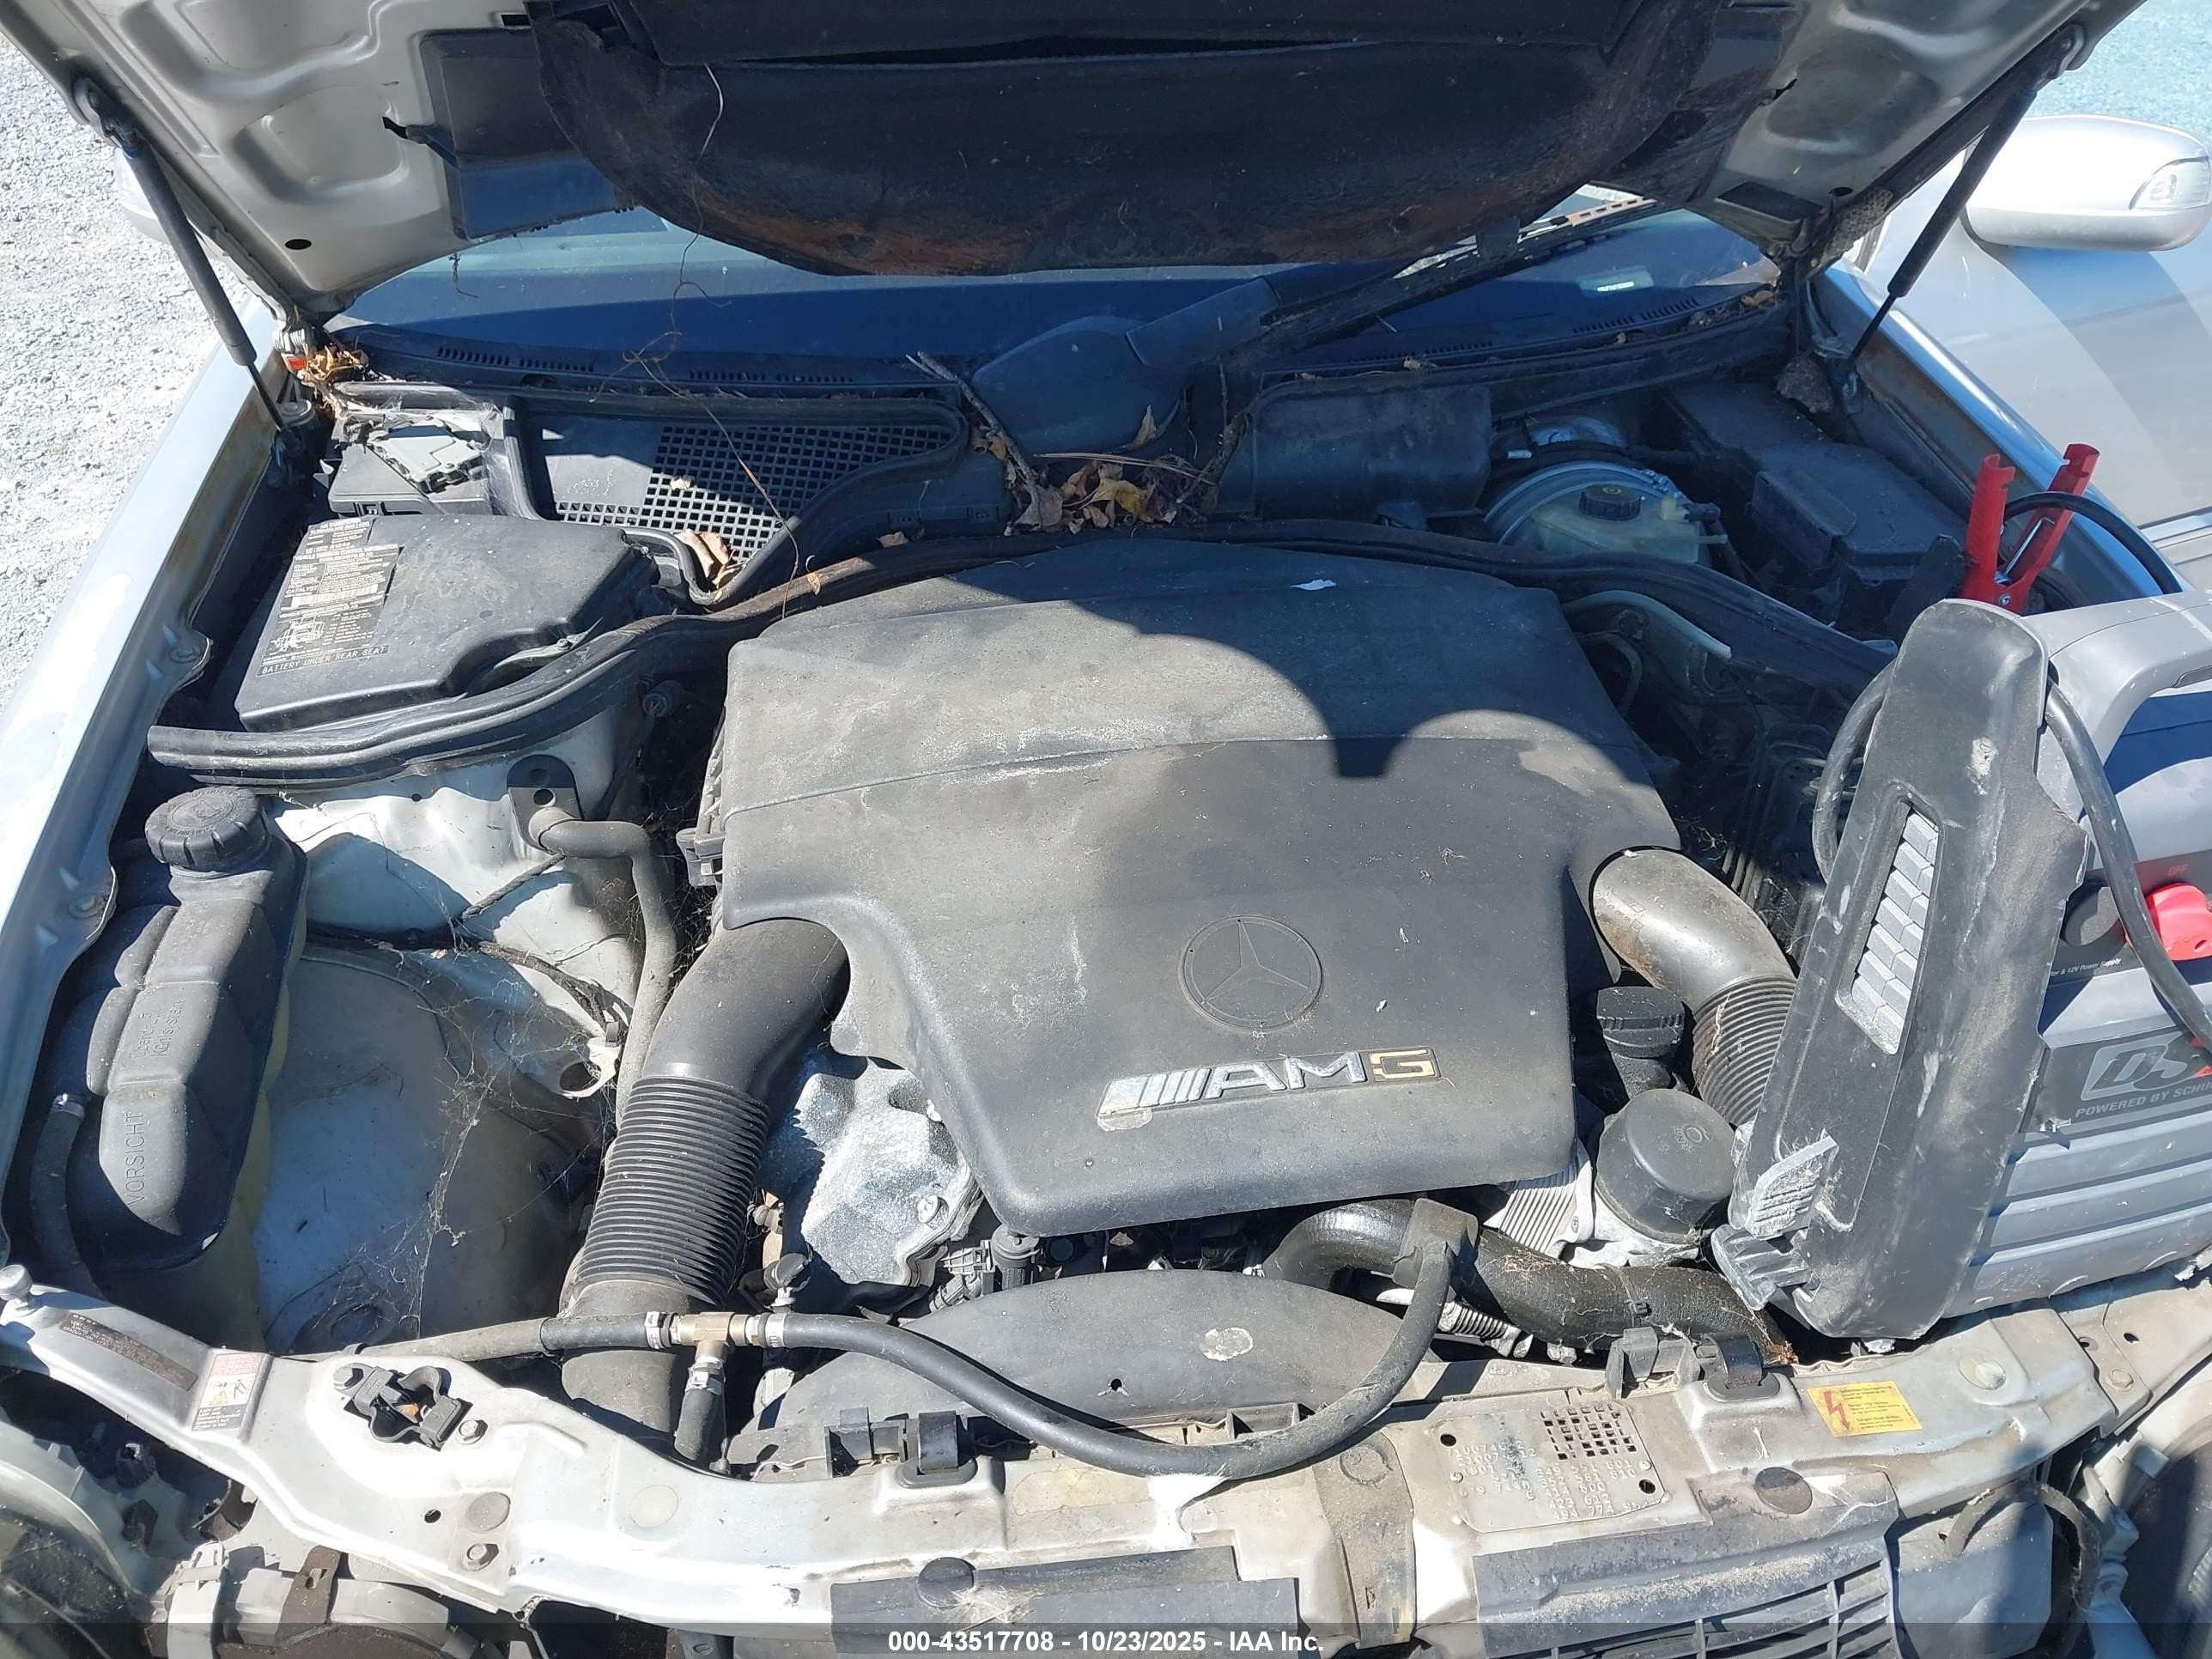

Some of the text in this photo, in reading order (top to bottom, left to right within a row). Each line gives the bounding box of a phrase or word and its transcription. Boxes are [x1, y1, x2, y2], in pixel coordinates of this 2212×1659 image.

[262, 660, 301, 673] BATTERY
[304, 655, 331, 666] UNDER
[335, 651, 357, 660] REAR
[362, 647, 385, 656] SEAT
[2100, 957, 2122, 968] Supply
[1204, 1048, 1437, 1099] AMG
[2075, 1080, 2212, 1117] POWERED BY SCHU
[124, 1111, 146, 1206] VORSICHT
